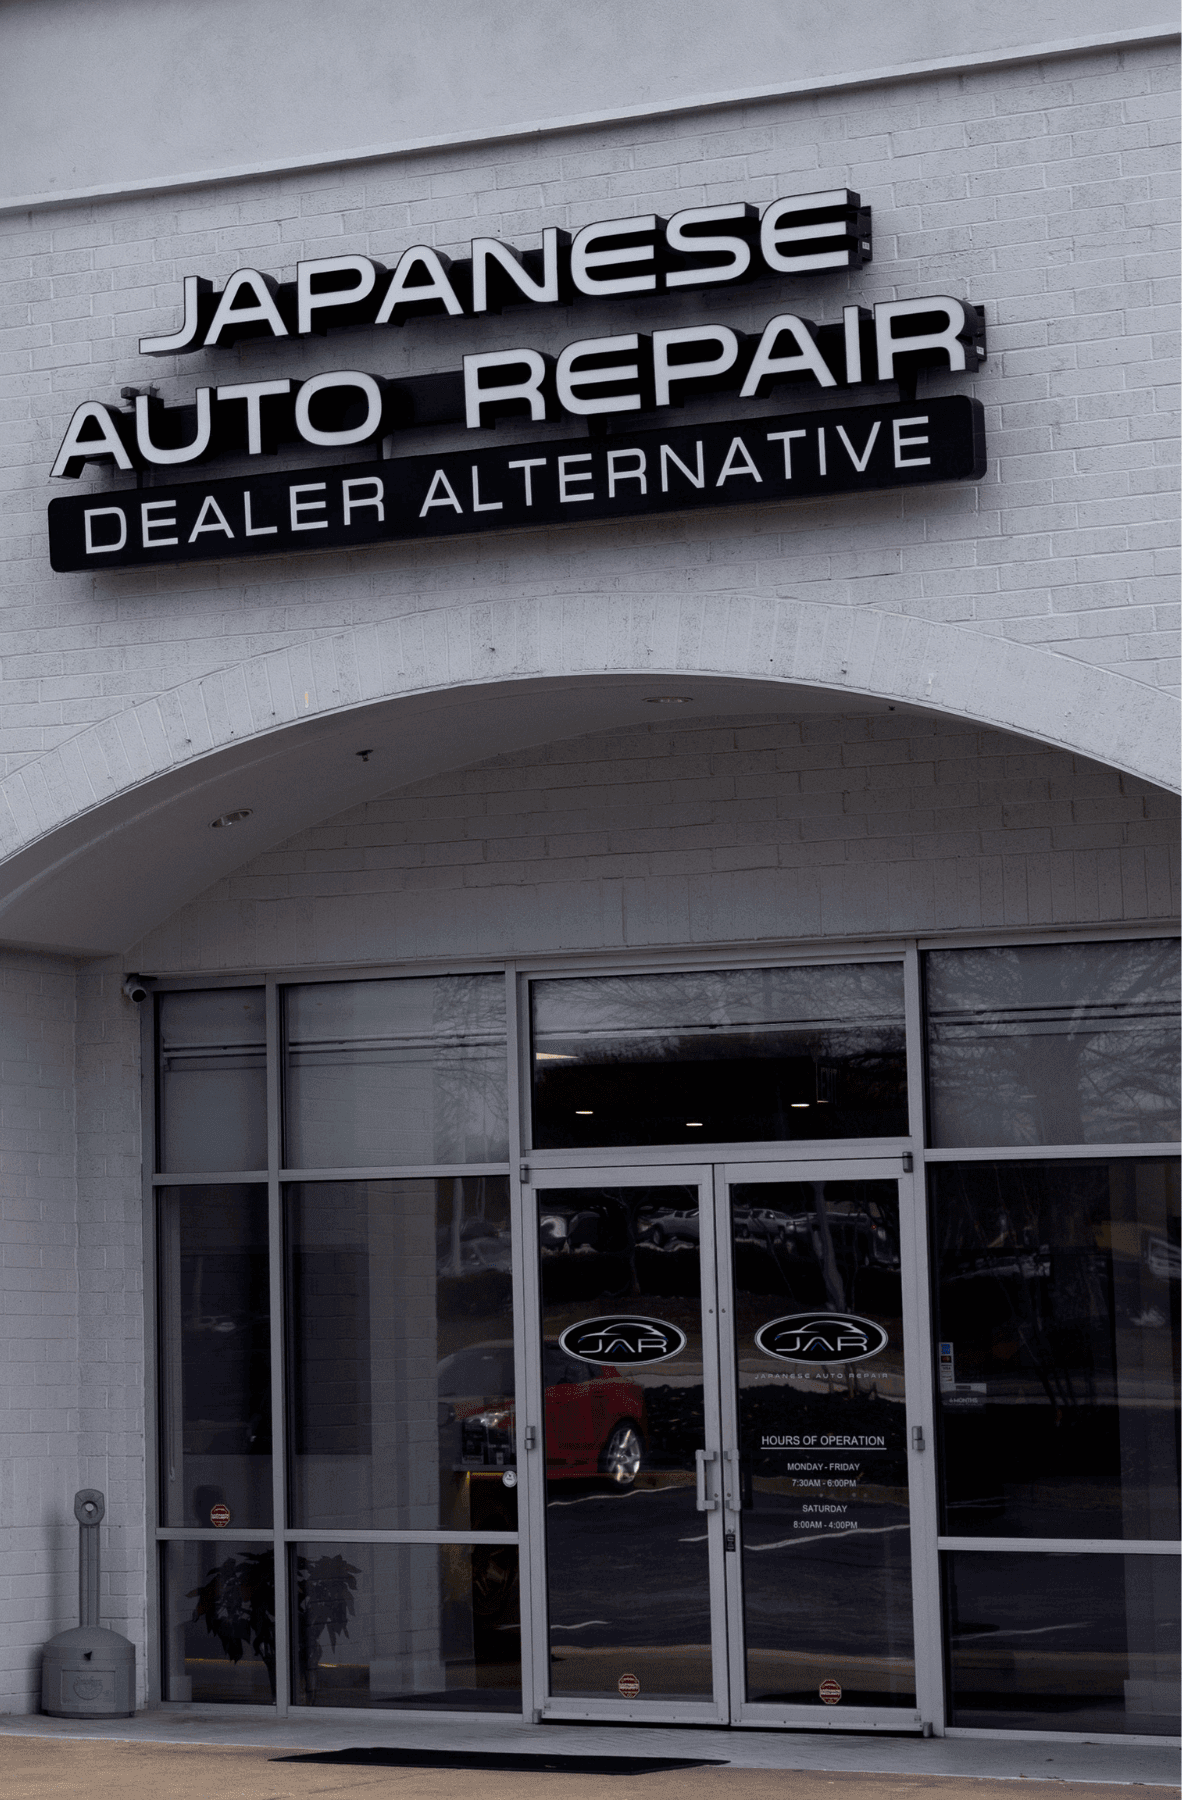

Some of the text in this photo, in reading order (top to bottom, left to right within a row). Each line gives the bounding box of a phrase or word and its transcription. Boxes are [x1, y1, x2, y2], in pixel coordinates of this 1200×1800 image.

[138, 188, 851, 356] JAPANESE
[49, 296, 966, 478] AUTO REPAIR
[84, 415, 933, 555] DEALER ALTERNATIVE
[579, 1338, 667, 1353] JAR
[776, 1336, 867, 1351] JAR
[761, 1435, 885, 1446] HOURS OF OPERATION
[787, 1462, 823, 1471] MONDAY
[829, 1462, 860, 1471] FRIDAY
[792, 1479, 821, 1487] 7:30AM
[827, 1479, 857, 1487] 6:00PM
[802, 1504, 848, 1513] SATURDAY
[793, 1520, 822, 1529] 8:00AM
[828, 1521, 858, 1529] 4:00PM
